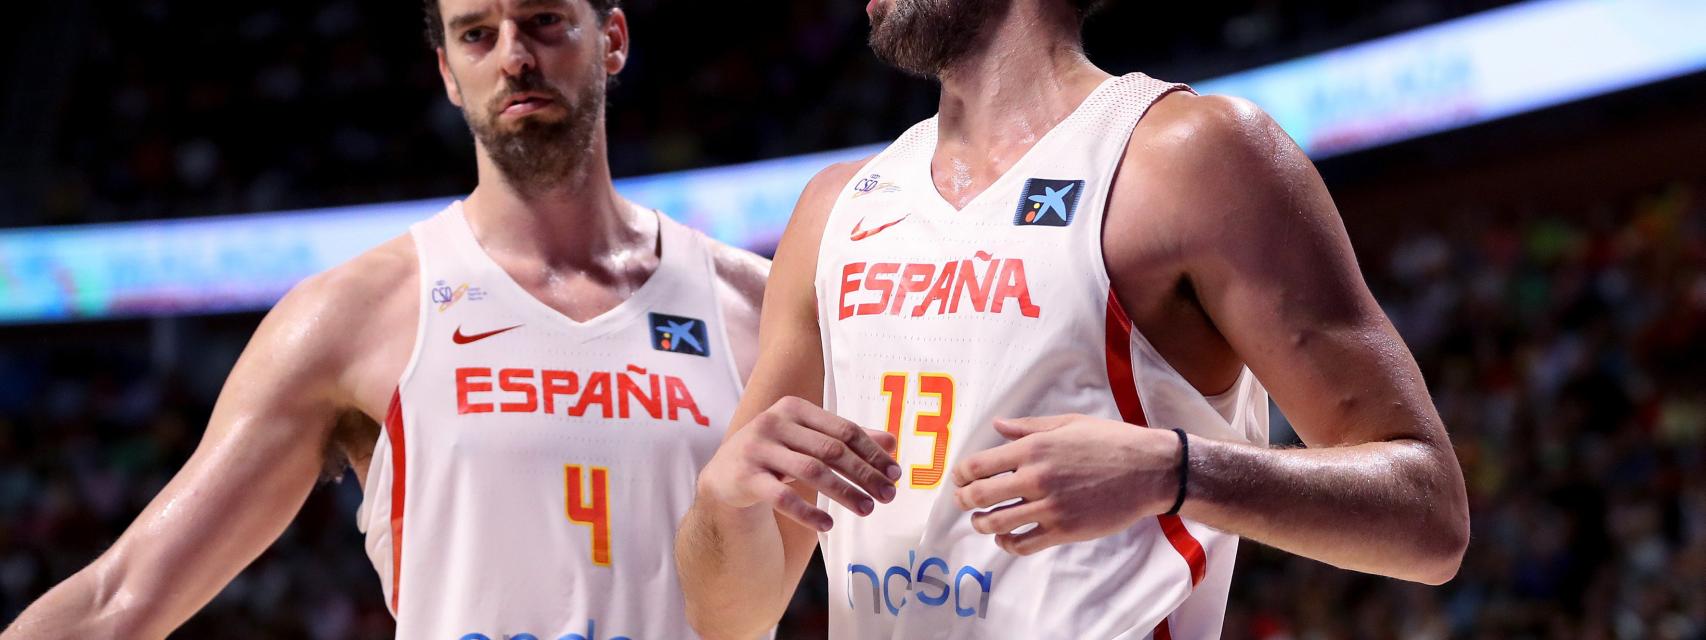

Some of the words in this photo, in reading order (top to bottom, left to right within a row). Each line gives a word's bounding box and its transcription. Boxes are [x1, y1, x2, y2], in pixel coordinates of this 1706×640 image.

[839, 250, 1041, 320] ESPAÑA
[455, 363, 711, 428] ESPAÑA
[880, 372, 956, 490] 13
[564, 463, 612, 568] 4
